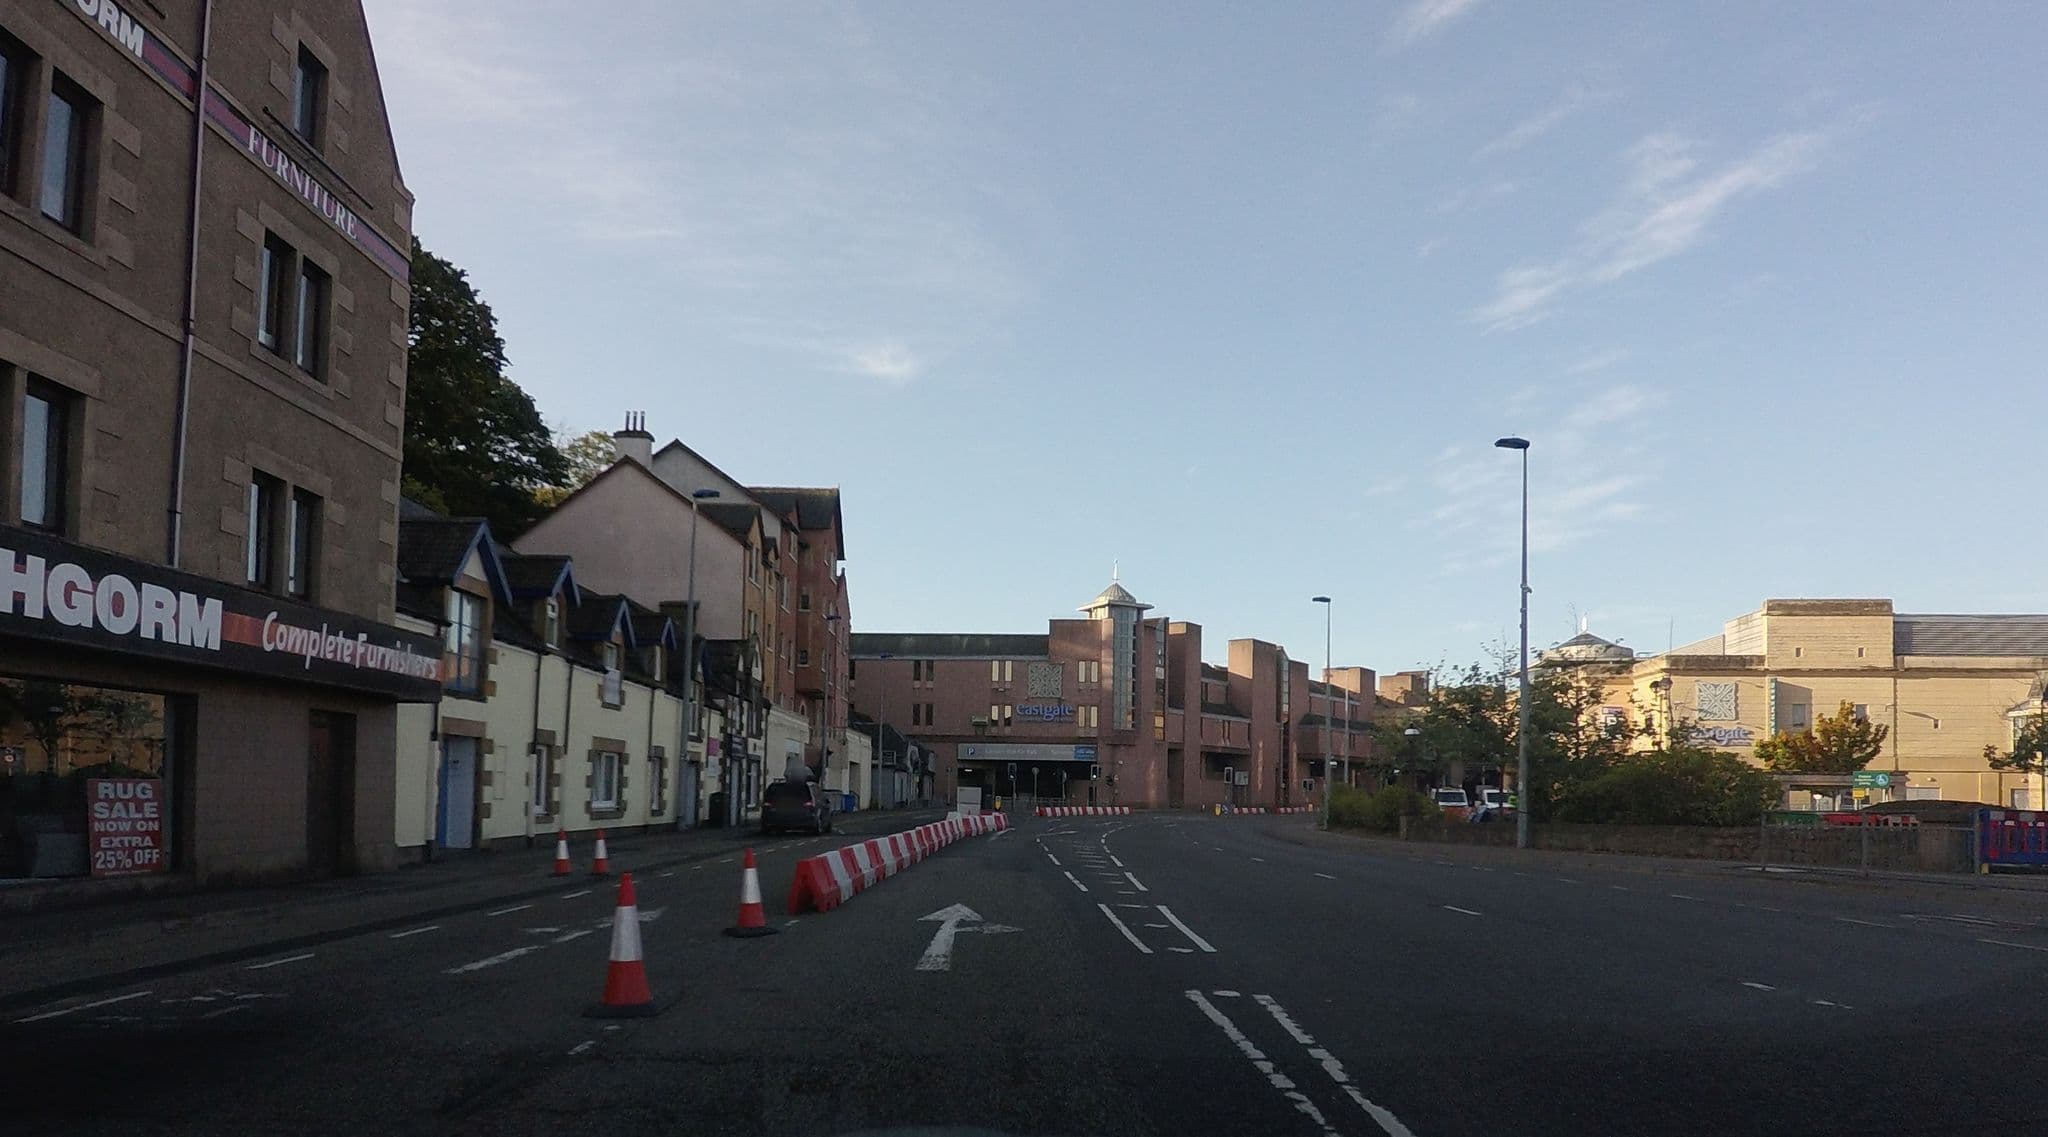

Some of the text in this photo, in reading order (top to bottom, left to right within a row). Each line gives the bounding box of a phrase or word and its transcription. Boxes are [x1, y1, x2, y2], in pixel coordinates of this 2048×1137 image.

[247, 125, 359, 240] FURNITURE
[262, 611, 354, 670] Complete
[355, 633, 437, 678] Furnishers
[1016, 704, 1073, 721] eastgate
[98, 782, 153, 799] RUG
[94, 802, 159, 818] SALE
[94, 821, 160, 832] NOW ON
[100, 836, 154, 848] EXTRA
[95, 849, 160, 869] 25% OFF
